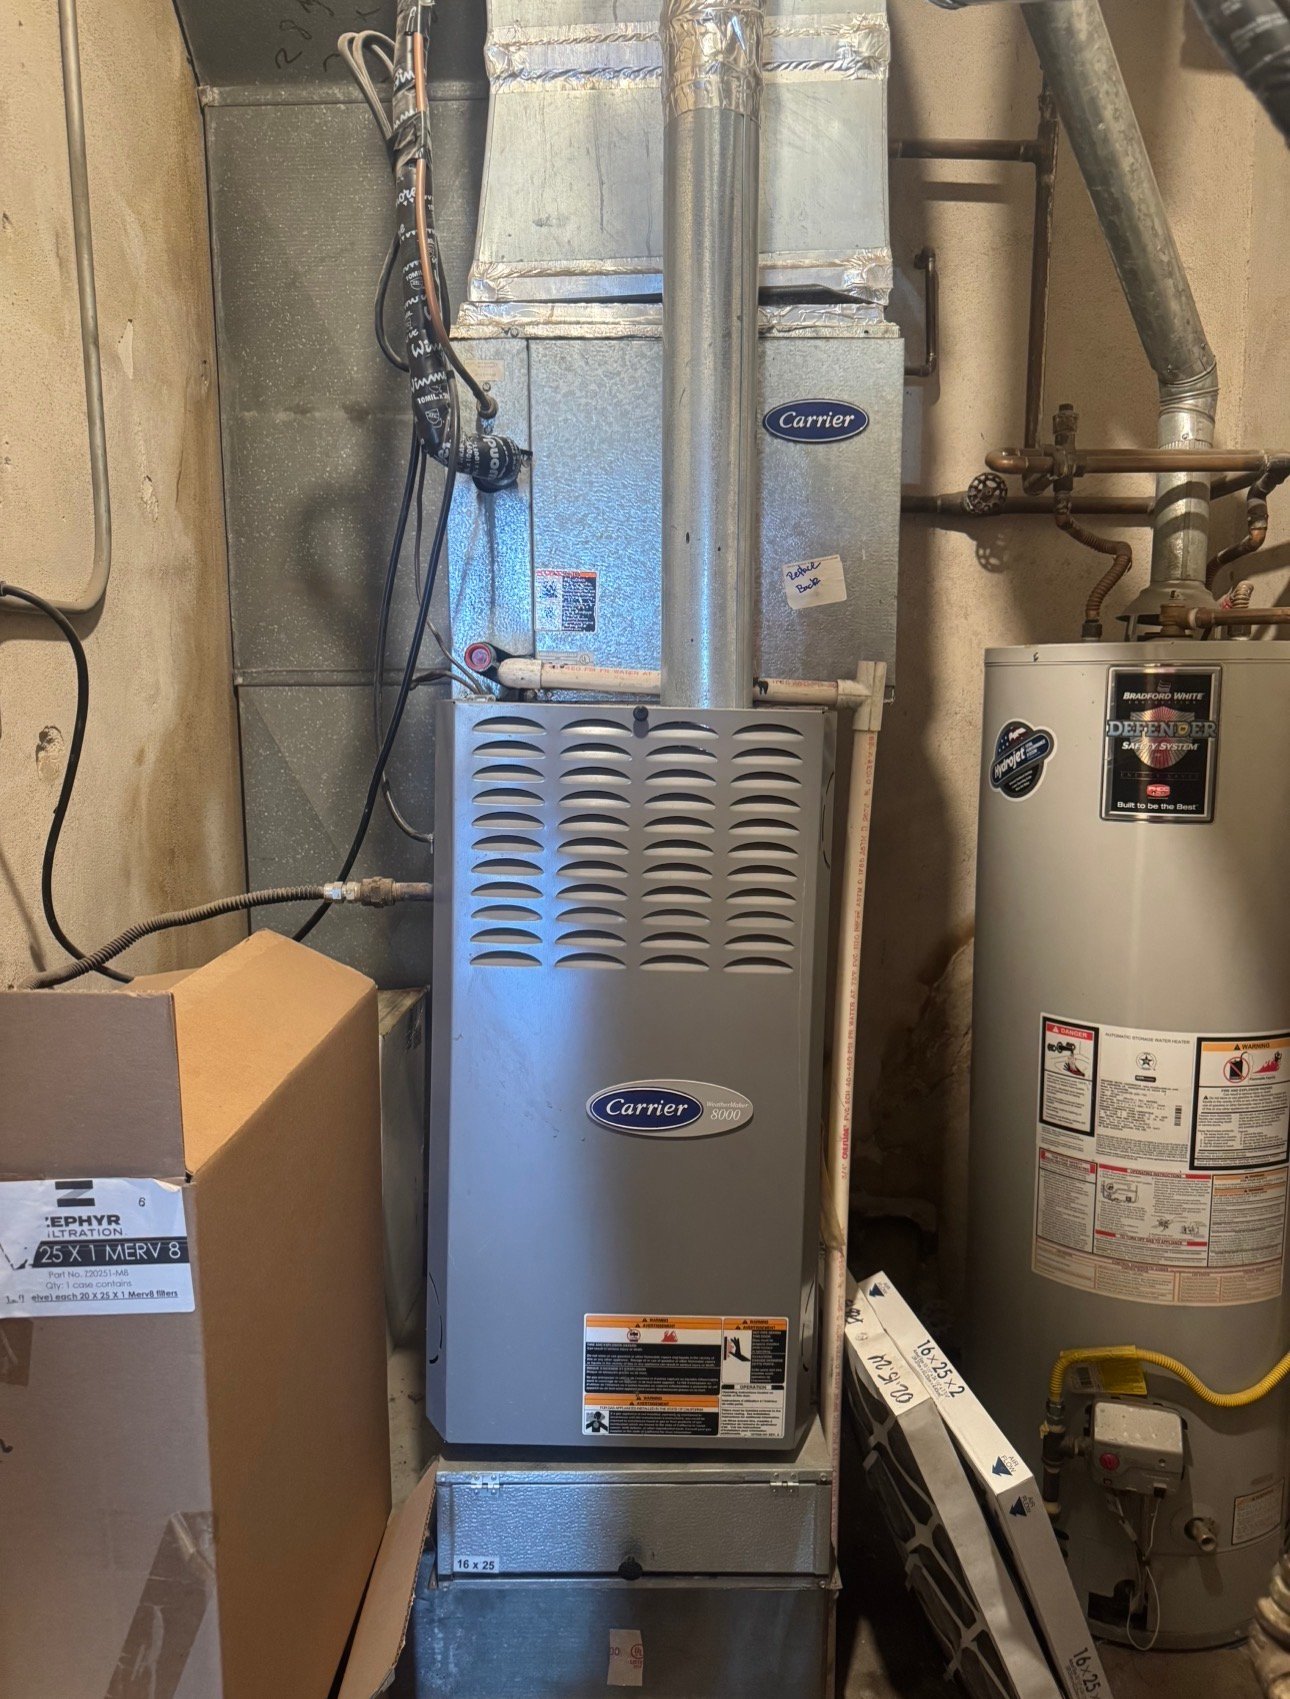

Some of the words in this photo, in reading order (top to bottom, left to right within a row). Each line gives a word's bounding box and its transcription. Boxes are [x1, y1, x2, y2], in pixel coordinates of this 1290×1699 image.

[779, 411, 855, 428] Carrier
[1123, 692, 1172, 700] BRADFORD
[1107, 720, 1216, 738] DEFENDER
[1159, 742, 1198, 750] SYSTEM
[994, 746, 1026, 779] Hydrojet
[1060, 1028, 1088, 1038] DANGER
[606, 1098, 688, 1116] Carrier
[710, 1108, 741, 1121] 8000
[138, 1197, 146, 1207] 6
[40, 1246, 63, 1263] 25
[68, 1245, 82, 1262] X
[89, 1244, 96, 1262] 1
[106, 1242, 161, 1262] MERV
[169, 1241, 181, 1259] 8
[48, 1270, 66, 1279] Part
[68, 1270, 82, 1279] No.
[46, 1281, 64, 1291] Qty:
[96, 1280, 132, 1288] contains
[56, 1292, 78, 1300] each
[80, 1292, 90, 1300] 20
[92, 1292, 98, 1300] X
[100, 1292, 110, 1300] 25
[1001, 1455, 1016, 1472] FLOW
[1008, 1456, 1020, 1466] AIR
[458, 1560, 470, 1569] 16
[482, 1561, 495, 1570] 25
